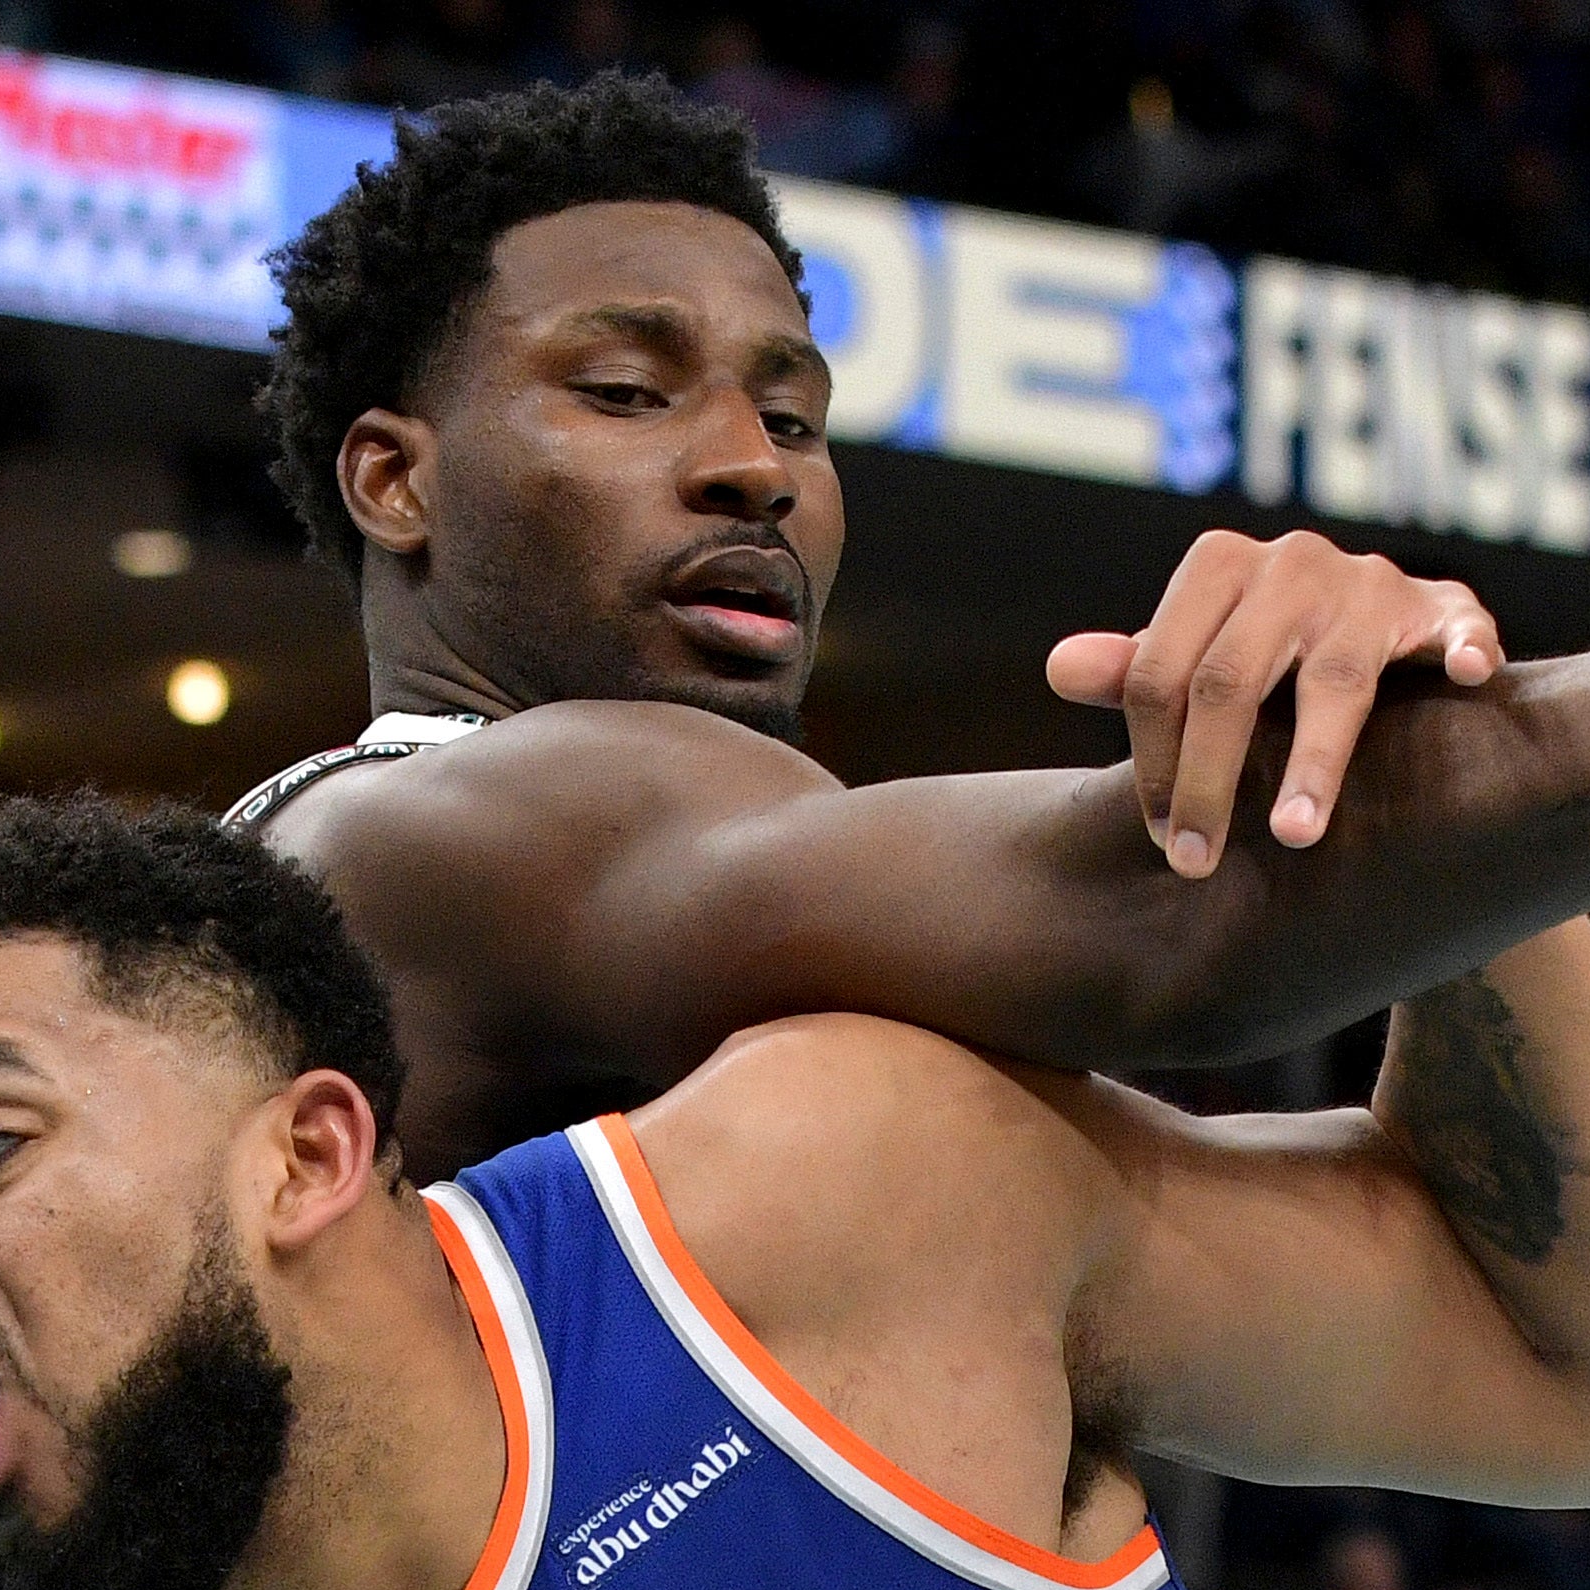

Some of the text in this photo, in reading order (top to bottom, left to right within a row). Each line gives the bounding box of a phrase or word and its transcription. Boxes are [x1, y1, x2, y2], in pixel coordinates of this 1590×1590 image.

[558, 1478, 653, 1555] experience
[575, 1425, 752, 1586] abu dhabi
